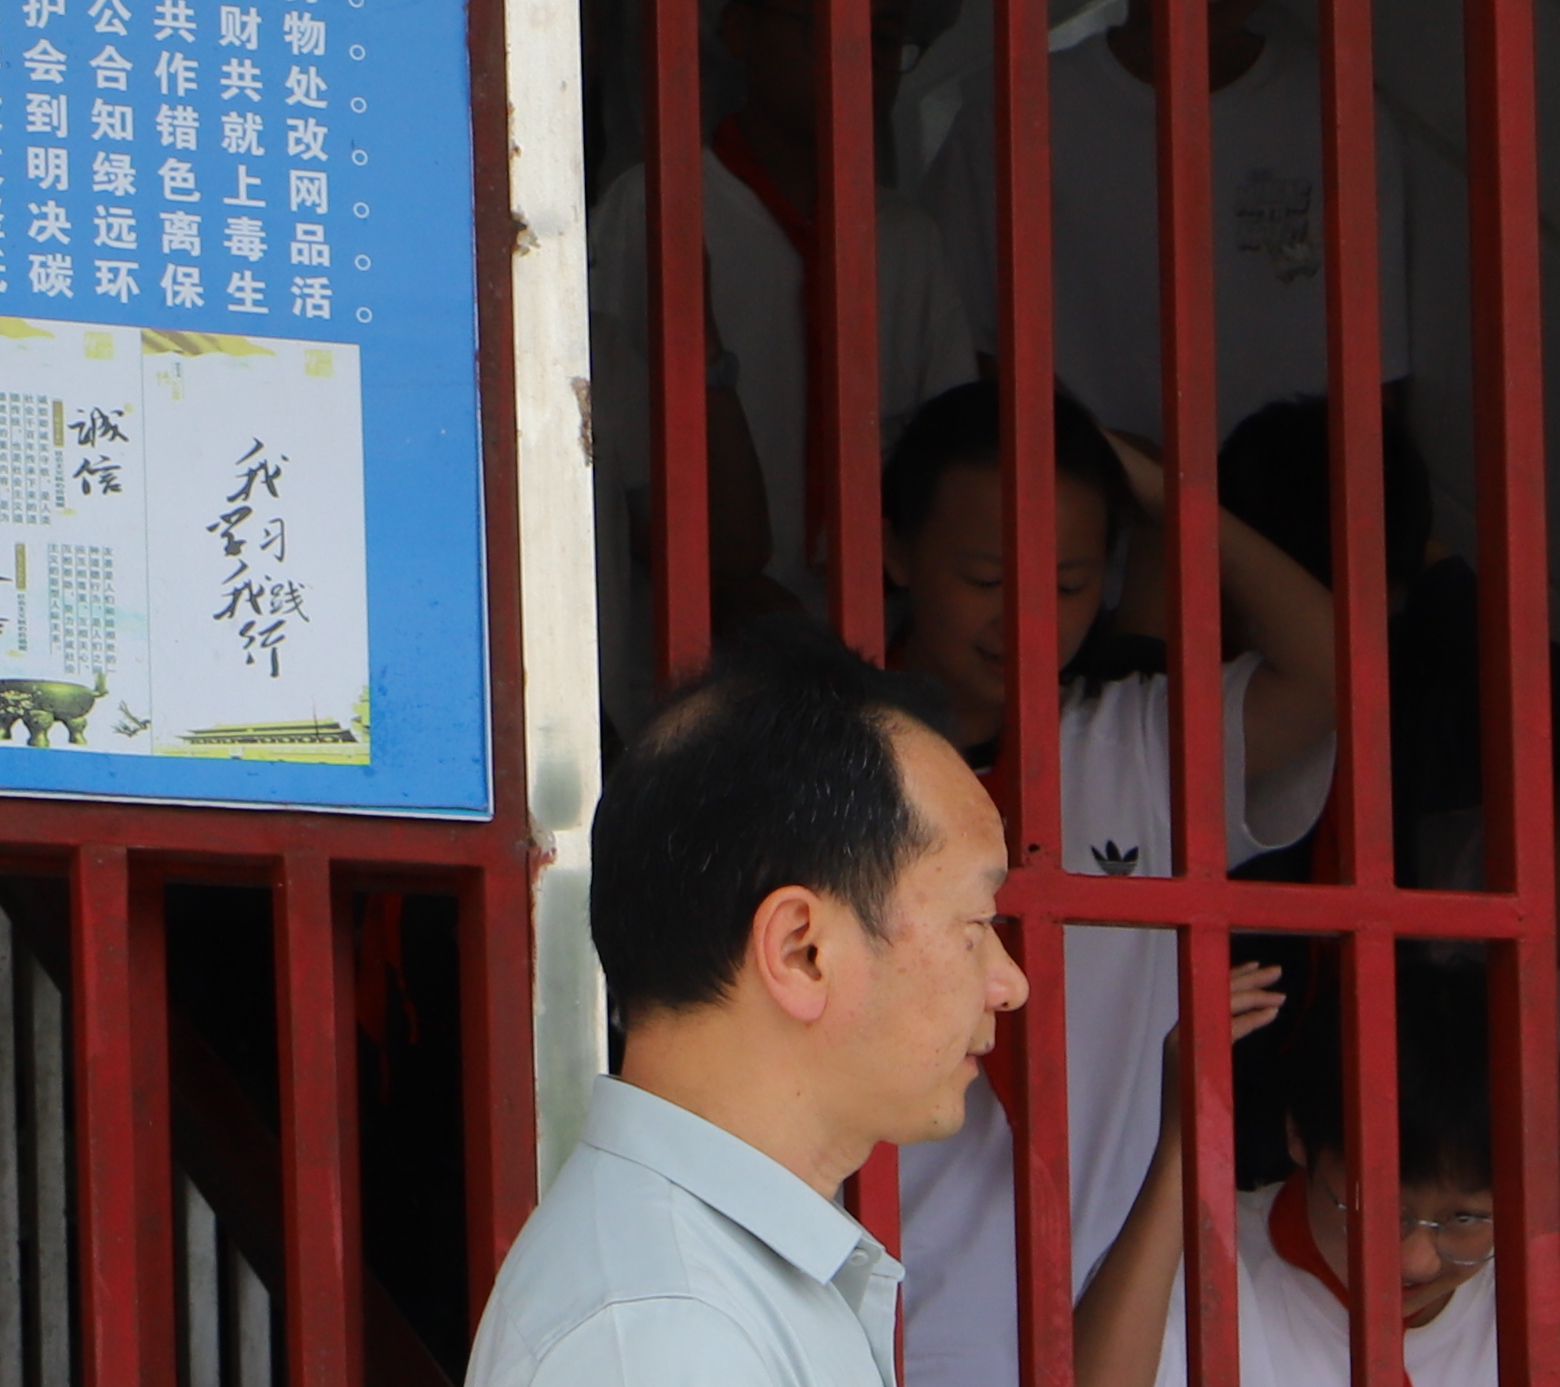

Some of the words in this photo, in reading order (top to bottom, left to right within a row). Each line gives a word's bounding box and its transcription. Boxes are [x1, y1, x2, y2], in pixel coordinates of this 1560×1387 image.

[0, 92, 368, 167] 到知错就改。
[0, 146, 370, 219] 明绿色上网。
[0, 198, 372, 271] 决远离毒品。
[0, 250, 373, 325] 碳环保生活。
